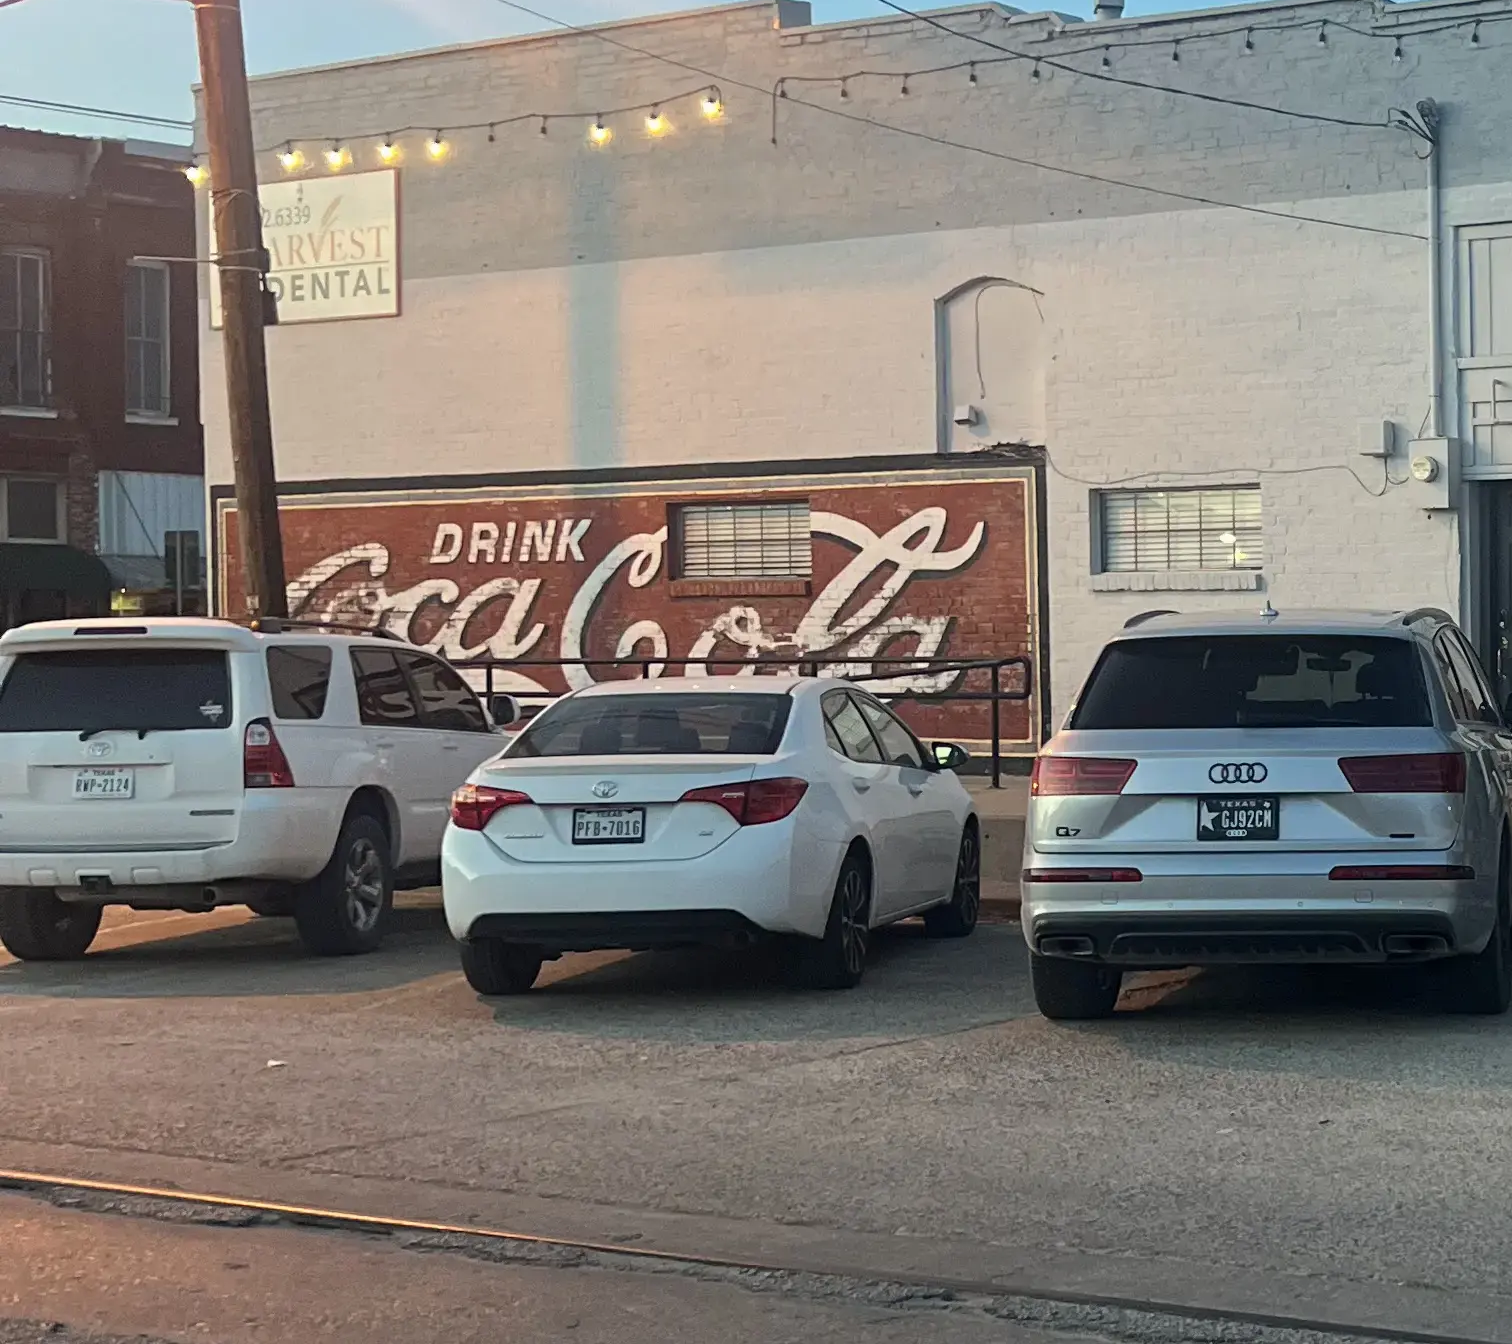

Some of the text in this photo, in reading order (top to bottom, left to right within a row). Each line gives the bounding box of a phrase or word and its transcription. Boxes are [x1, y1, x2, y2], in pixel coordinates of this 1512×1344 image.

[266, 267, 392, 304] DENTAL
[429, 518, 593, 564] DRINK
[1055, 826, 1081, 837] Q7
